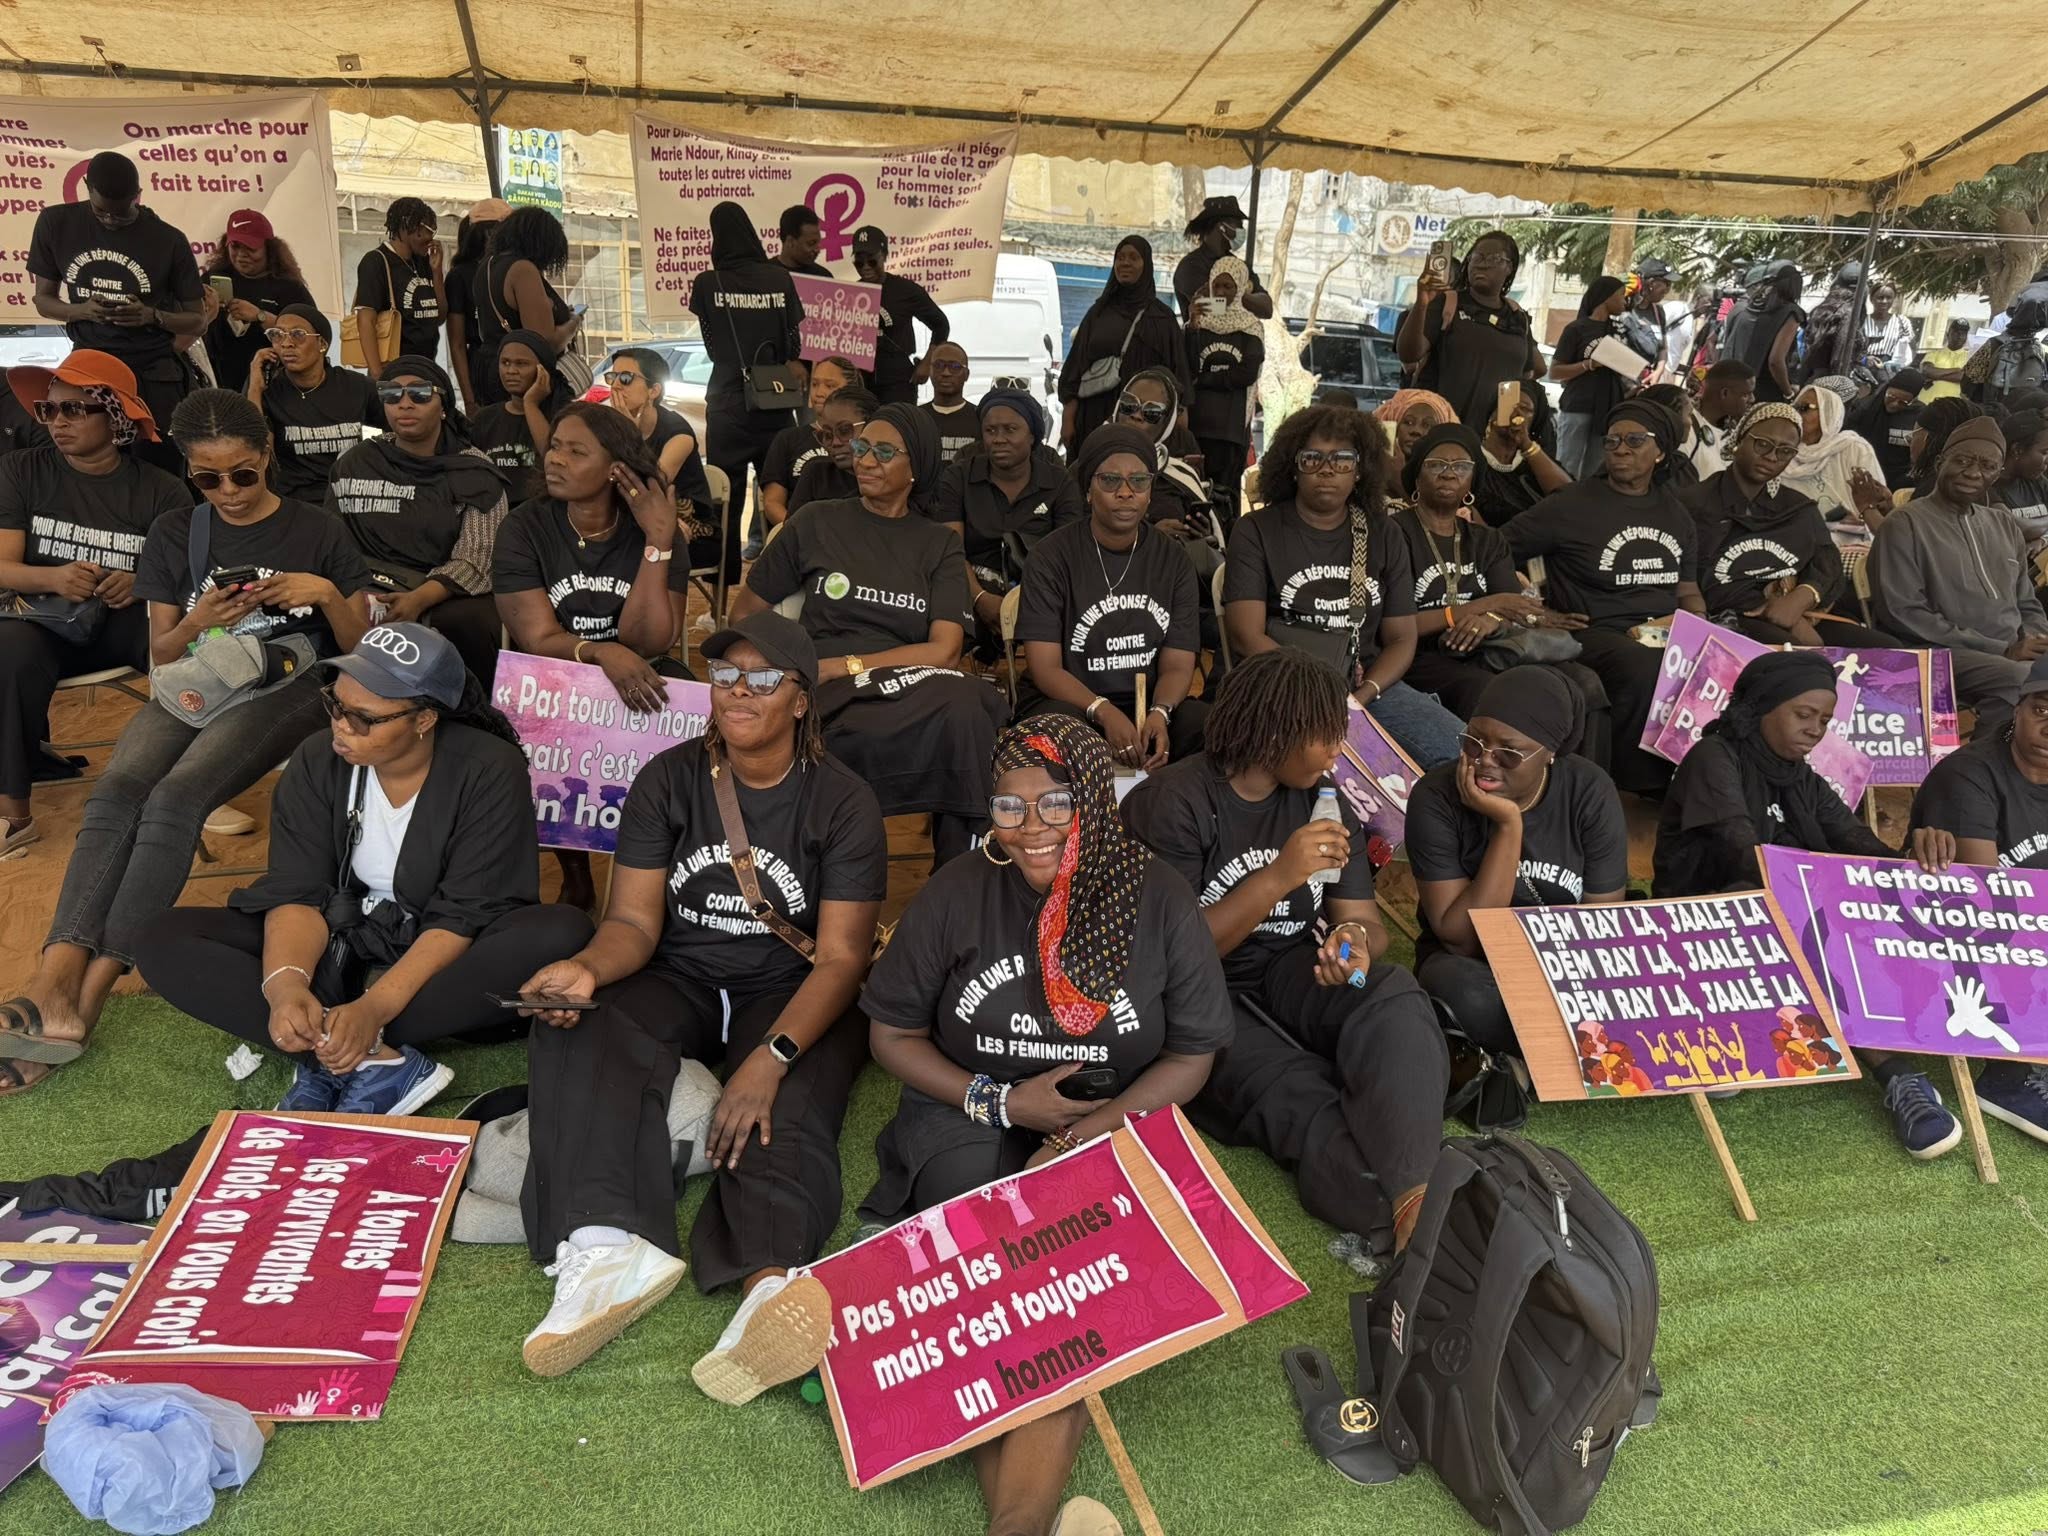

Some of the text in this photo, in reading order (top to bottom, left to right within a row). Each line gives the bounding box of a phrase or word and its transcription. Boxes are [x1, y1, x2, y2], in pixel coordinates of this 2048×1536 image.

[123, 118, 309, 138] On marche pour
[647, 125, 670, 139] Pour
[5, 151, 55, 169] vies.
[139, 144, 198, 162] celles
[273, 150, 287, 163] a
[651, 146, 683, 162] Marie
[685, 145, 723, 162] Ndour,
[941, 153, 974, 168] de 12
[151, 172, 263, 192] fait taire !
[659, 166, 792, 181] toutes les autres victimes
[881, 165, 976, 182] pour la violer.
[680, 183, 755, 200] du patriarcat.
[877, 178, 982, 195] les hommes sont
[654, 226, 711, 242] Ne faites
[900, 227, 972, 246] survivantes:
[657, 244, 678, 257] des
[929, 239, 993, 254] pas seules.
[66, 248, 151, 293] POUR UNE RÉPONSE URGENTE
[656, 260, 709, 274] éduquer
[899, 258, 954, 269] victimes:
[92, 277, 122, 290] CONTRE
[926, 269, 971, 281] battons
[7, 292, 27, 306] et
[77, 287, 90, 298] LES
[714, 292, 786, 309] LE PATRIARCAT TUE
[822, 300, 833, 320] la
[835, 303, 880, 328] violence
[806, 333, 837, 351] notre
[350, 478, 384, 497] REFORME
[383, 480, 416, 500] URGENTE
[364, 498, 373, 513] LA
[373, 498, 400, 513] FAMILLE
[32, 516, 112, 549] POUR UNE REFORME
[38, 538, 134, 571] DU CODE DE LA FAMILLE
[1599, 526, 1661, 571] POUR UNE RÉPONSE
[1724, 538, 1764, 561] RÉPONSE
[1763, 539, 1799, 567] URGENTE
[1632, 557, 1664, 570] CONTRE
[1280, 563, 1351, 609] POUR UNE RÉPONSE
[1423, 565, 1440, 585] UNE
[1616, 572, 1679, 585] LES FÉMINICIDES
[551, 578, 574, 602] UNE
[854, 584, 926, 613] music
[1314, 597, 1350, 611] CONTRE
[573, 615, 613, 630] CONTRE
[1070, 594, 1148, 652] POUR UNE RÉPONSE
[1106, 633, 1145, 651] CONTRE
[1088, 658, 1105, 671] LES
[879, 677, 901, 695] LES
[899, 666, 965, 689] FÉMINICIDES
[517, 674, 561, 719] Pas
[567, 686, 617, 728] tous
[2010, 838, 2036, 863] UNE
[669, 846, 807, 915] POUR UNE URGENTE
[1217, 857, 1247, 887] UNE
[1844, 864, 2035, 897] Mettons fin
[678, 904, 699, 924] LES
[1525, 906, 1584, 943] DËM
[1577, 906, 1629, 940] RAY
[1733, 896, 1771, 926] LA
[1839, 900, 1904, 923] aux
[1541, 927, 1790, 981] DËM RAY LA, JAALÉ LA
[955, 958, 1014, 1024] POUR UNE
[1557, 968, 1809, 1024] DËM RAY LA, JAALÉ LA
[976, 1033, 1109, 1063] LES FÉMINICIDES
[238, 1127, 305, 1150] de
[195, 1154, 296, 1205] viols,
[193, 1209, 251, 1235] on
[242, 1156, 369, 1306] les survivantes
[341, 1208, 420, 1271] toutes
[165, 1240, 238, 1291] vous
[842, 1191, 1134, 1343] Pas tous les hommes »
[133, 1295, 218, 1347] croit
[872, 1335, 944, 1392] mais
[1010, 1251, 1131, 1334] toujours
[953, 1328, 1109, 1422] un homme
